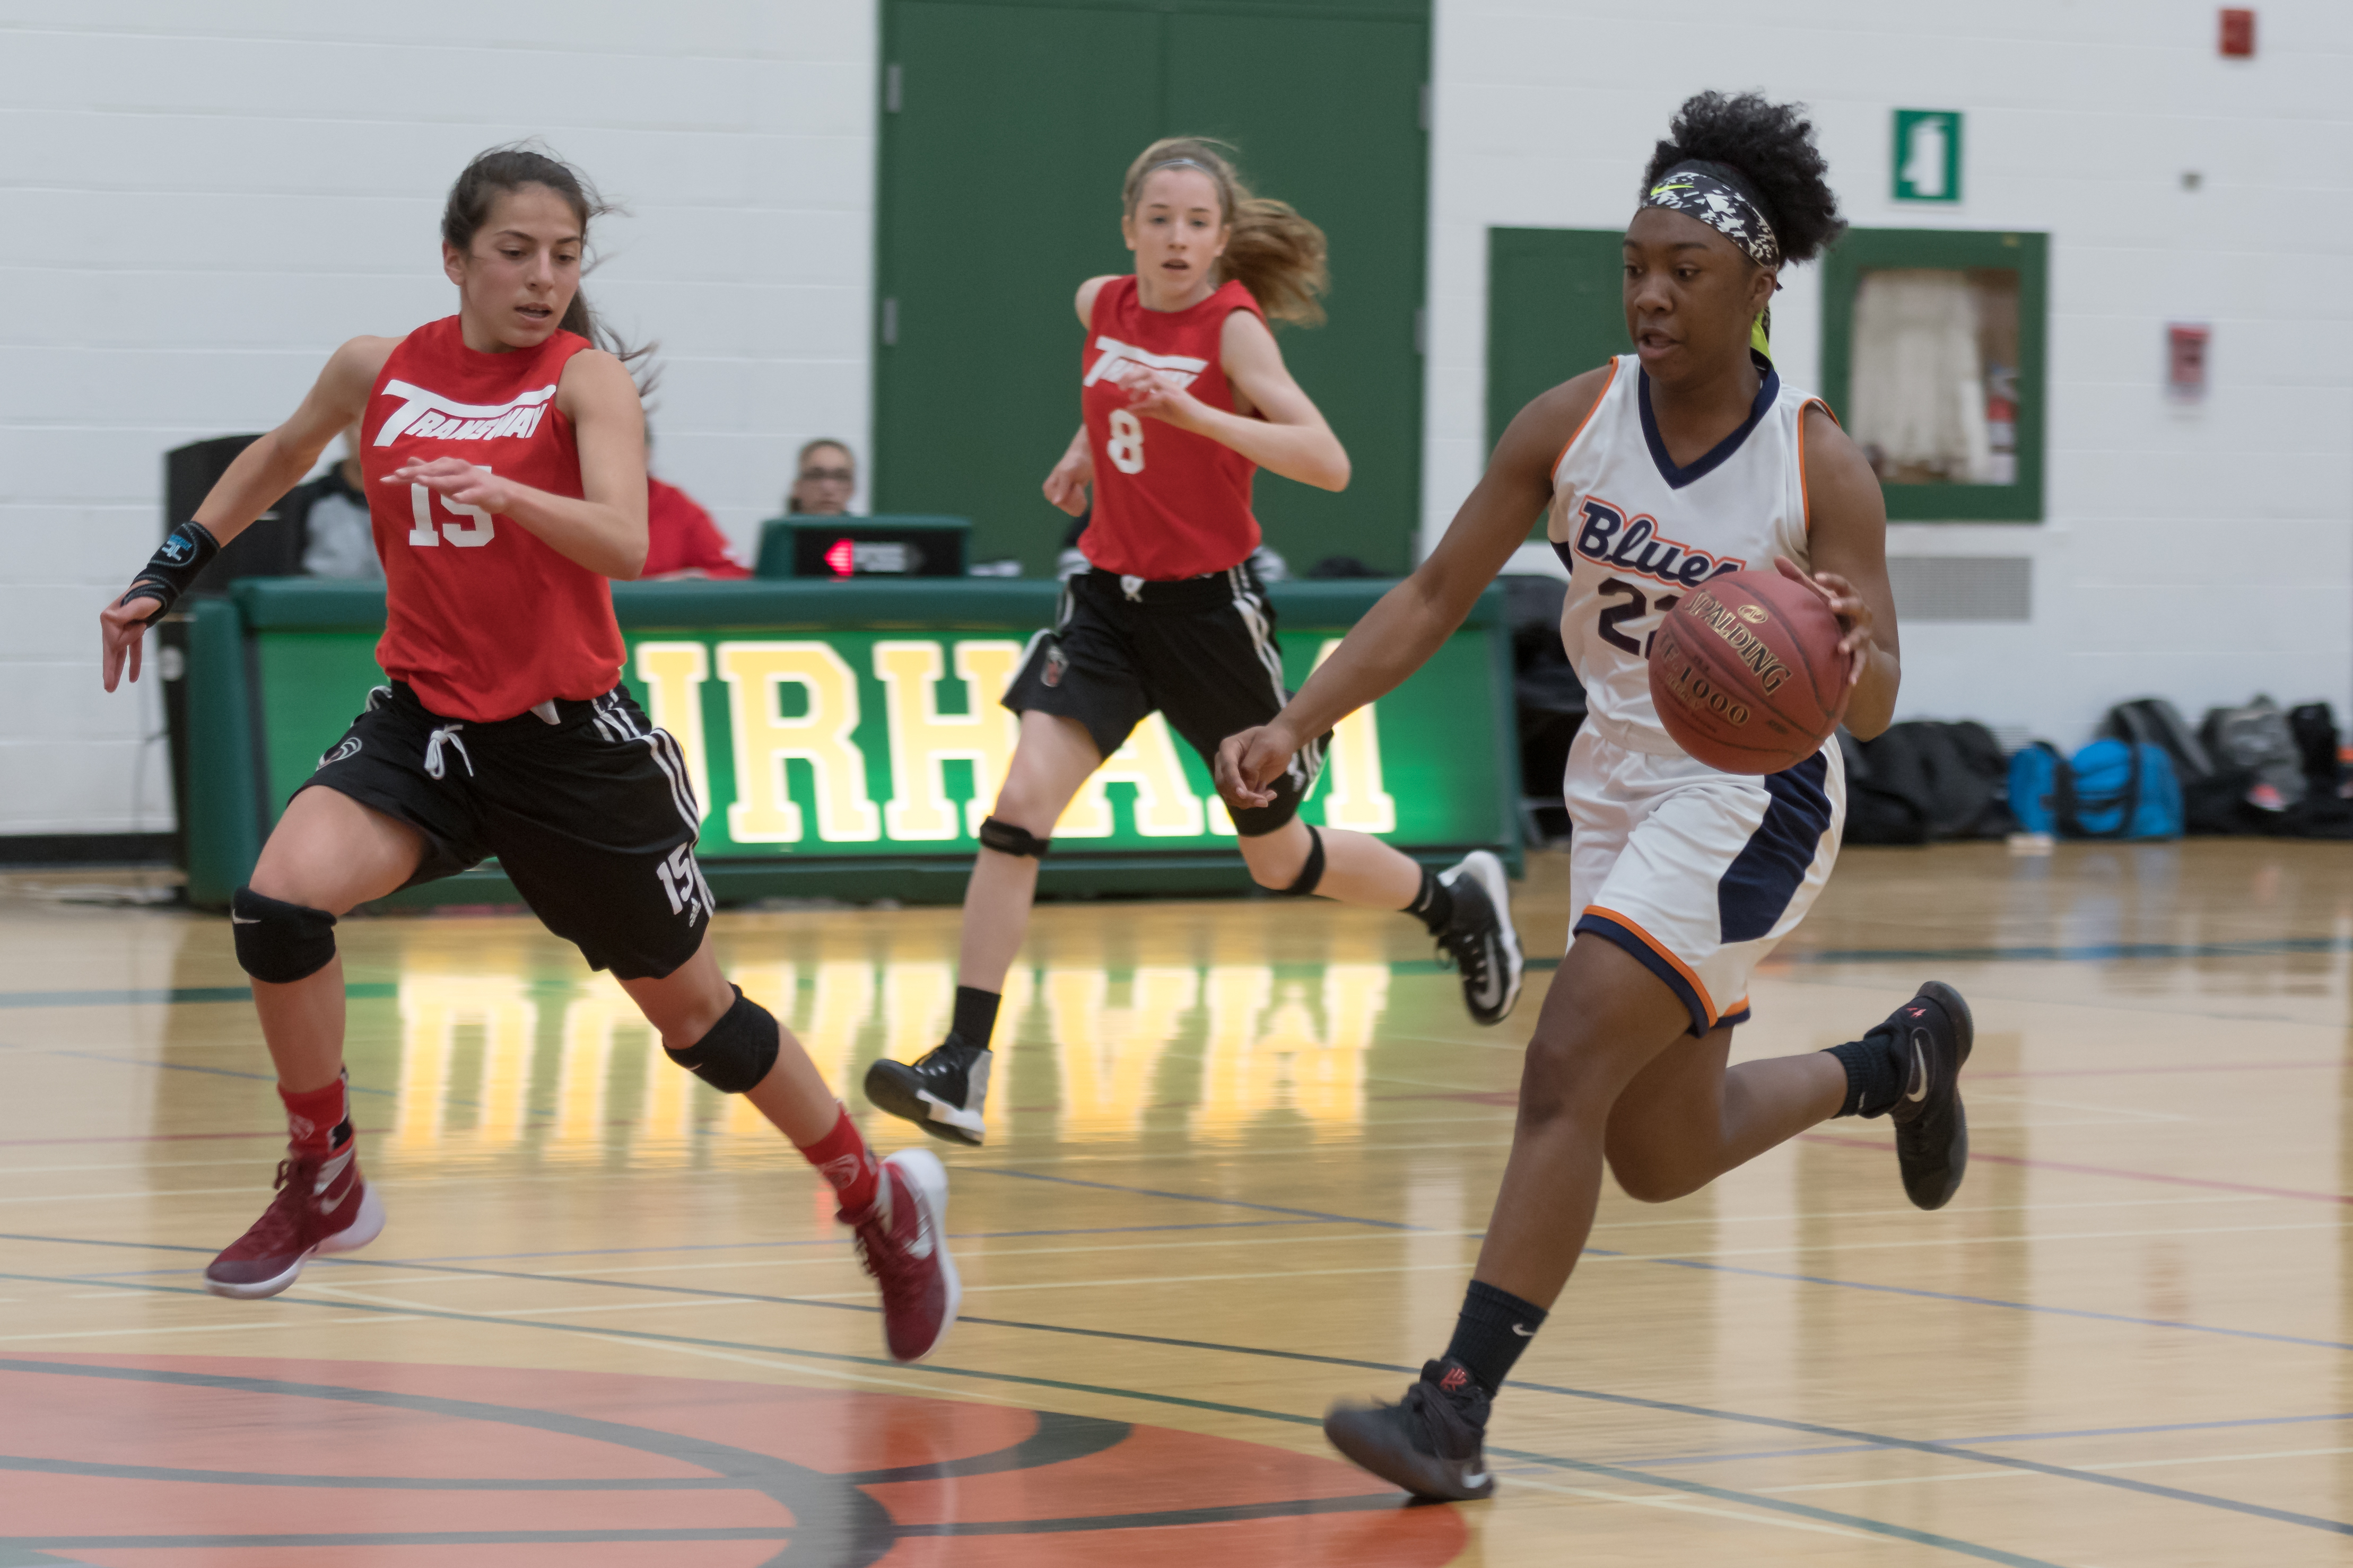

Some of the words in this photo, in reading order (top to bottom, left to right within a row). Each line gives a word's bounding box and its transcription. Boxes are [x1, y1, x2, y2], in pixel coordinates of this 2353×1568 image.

[373, 379, 556, 447] TRANSWAY
[1107, 409, 1145, 475] 8
[409, 466, 494, 547] 15
[1598, 576, 1681, 661] 2
[1683, 590, 1792, 696] SPALDING
[656, 841, 694, 915] 15
